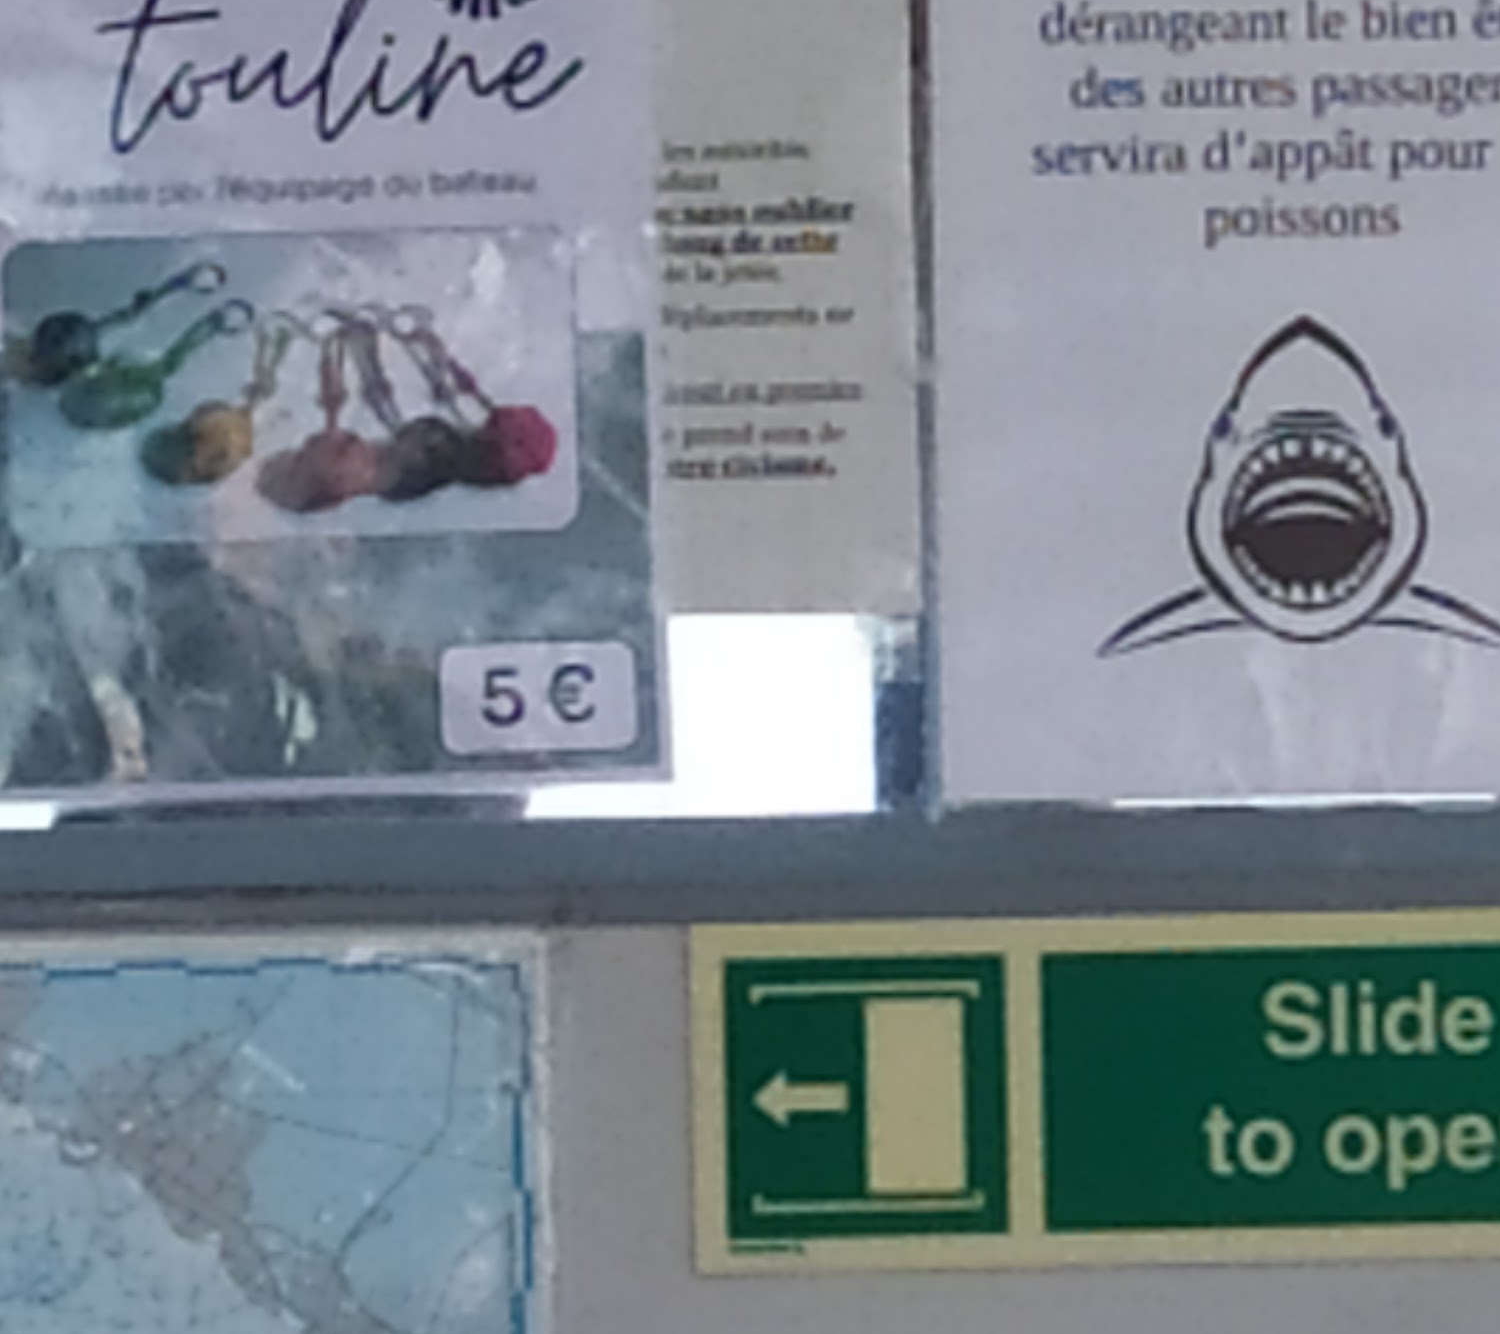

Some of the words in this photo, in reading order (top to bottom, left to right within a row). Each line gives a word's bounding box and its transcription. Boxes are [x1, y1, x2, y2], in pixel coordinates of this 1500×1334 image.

[1039, 1, 1288, 54] dérangeant
[1361, 0, 1456, 39] bien
[1070, 66, 1144, 108] des
[1160, 74, 1296, 107] autres
[1031, 137, 1186, 173] servira
[1203, 129, 1372, 183] d'appât
[1388, 138, 1493, 180] pour
[1203, 198, 1401, 249] poissons
[481, 666, 525, 728] 5
[548, 663, 596, 724] €
[1263, 981, 1495, 1058] Slide
[1204, 1105, 1294, 1176] to
